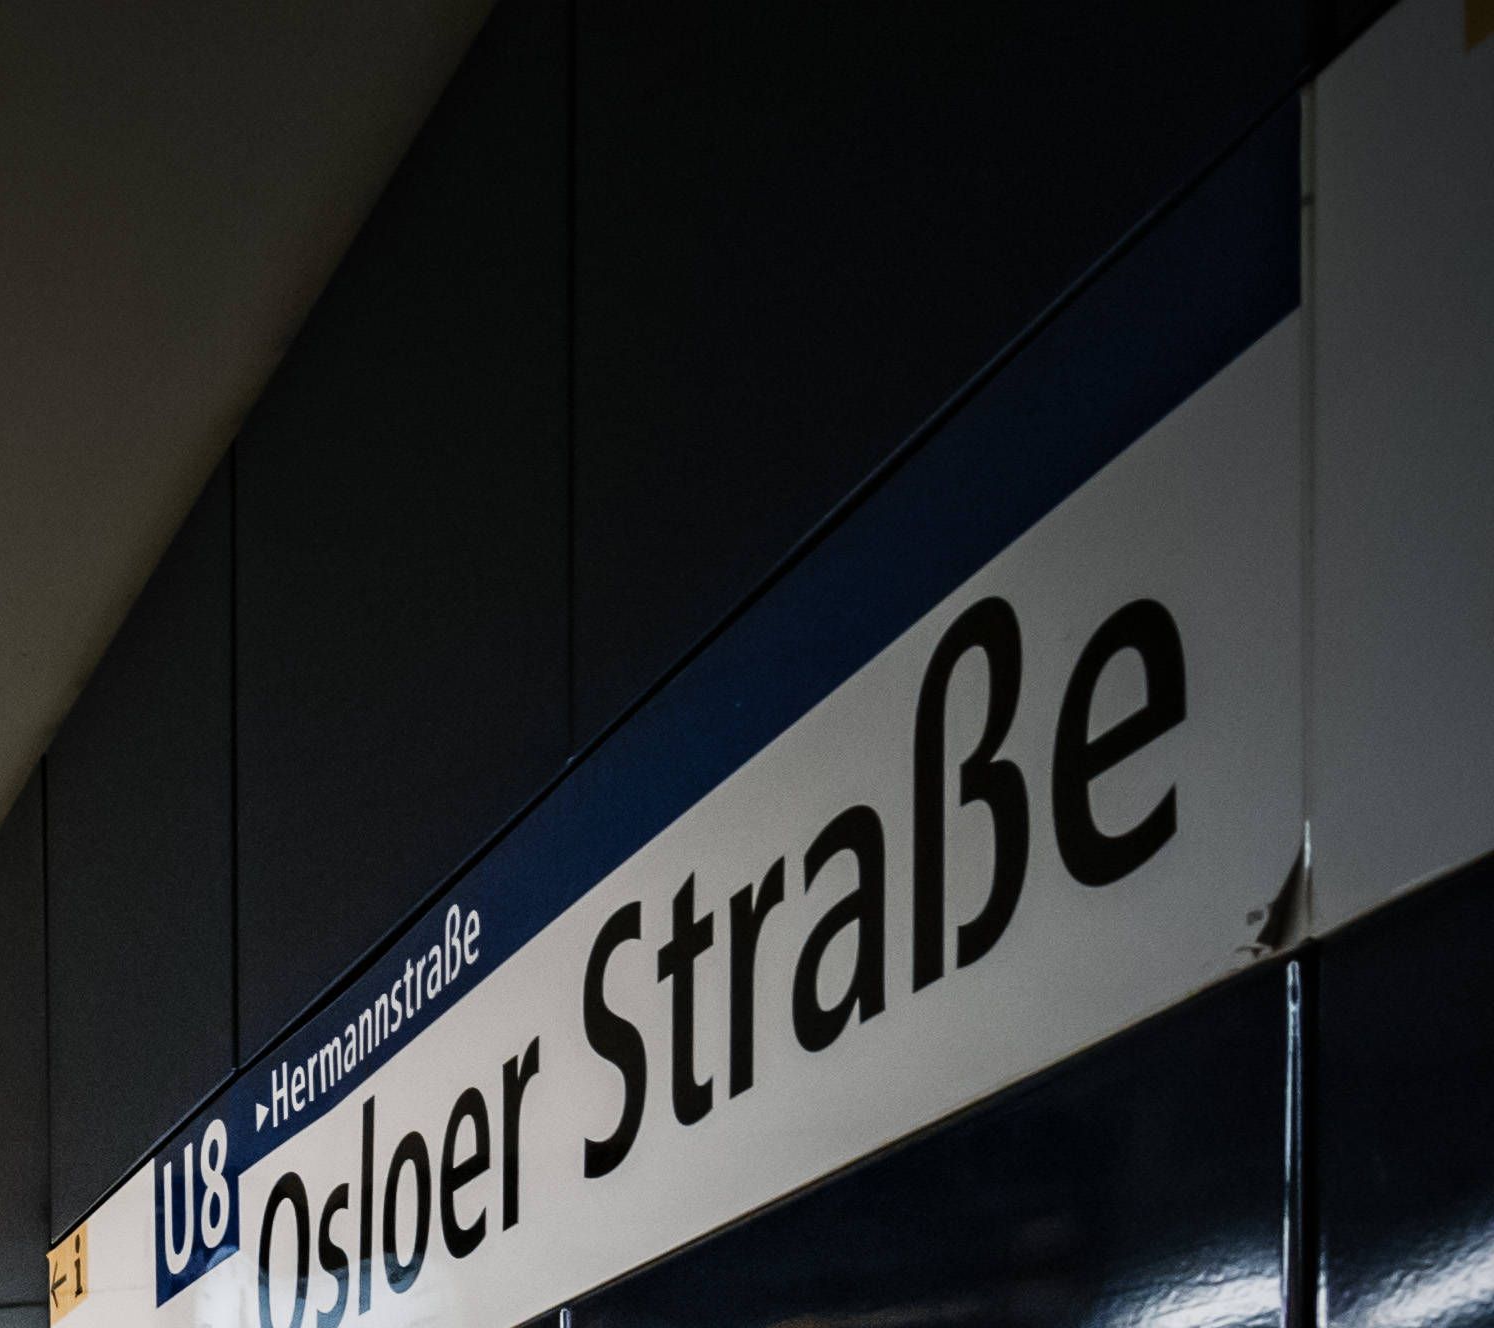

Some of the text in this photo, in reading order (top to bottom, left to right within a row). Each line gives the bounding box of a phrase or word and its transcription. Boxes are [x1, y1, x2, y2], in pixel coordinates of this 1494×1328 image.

[581, 594, 1188, 1180] Straße
[271, 903, 481, 1128] Hermannstraße
[162, 1118, 230, 1275] U8
